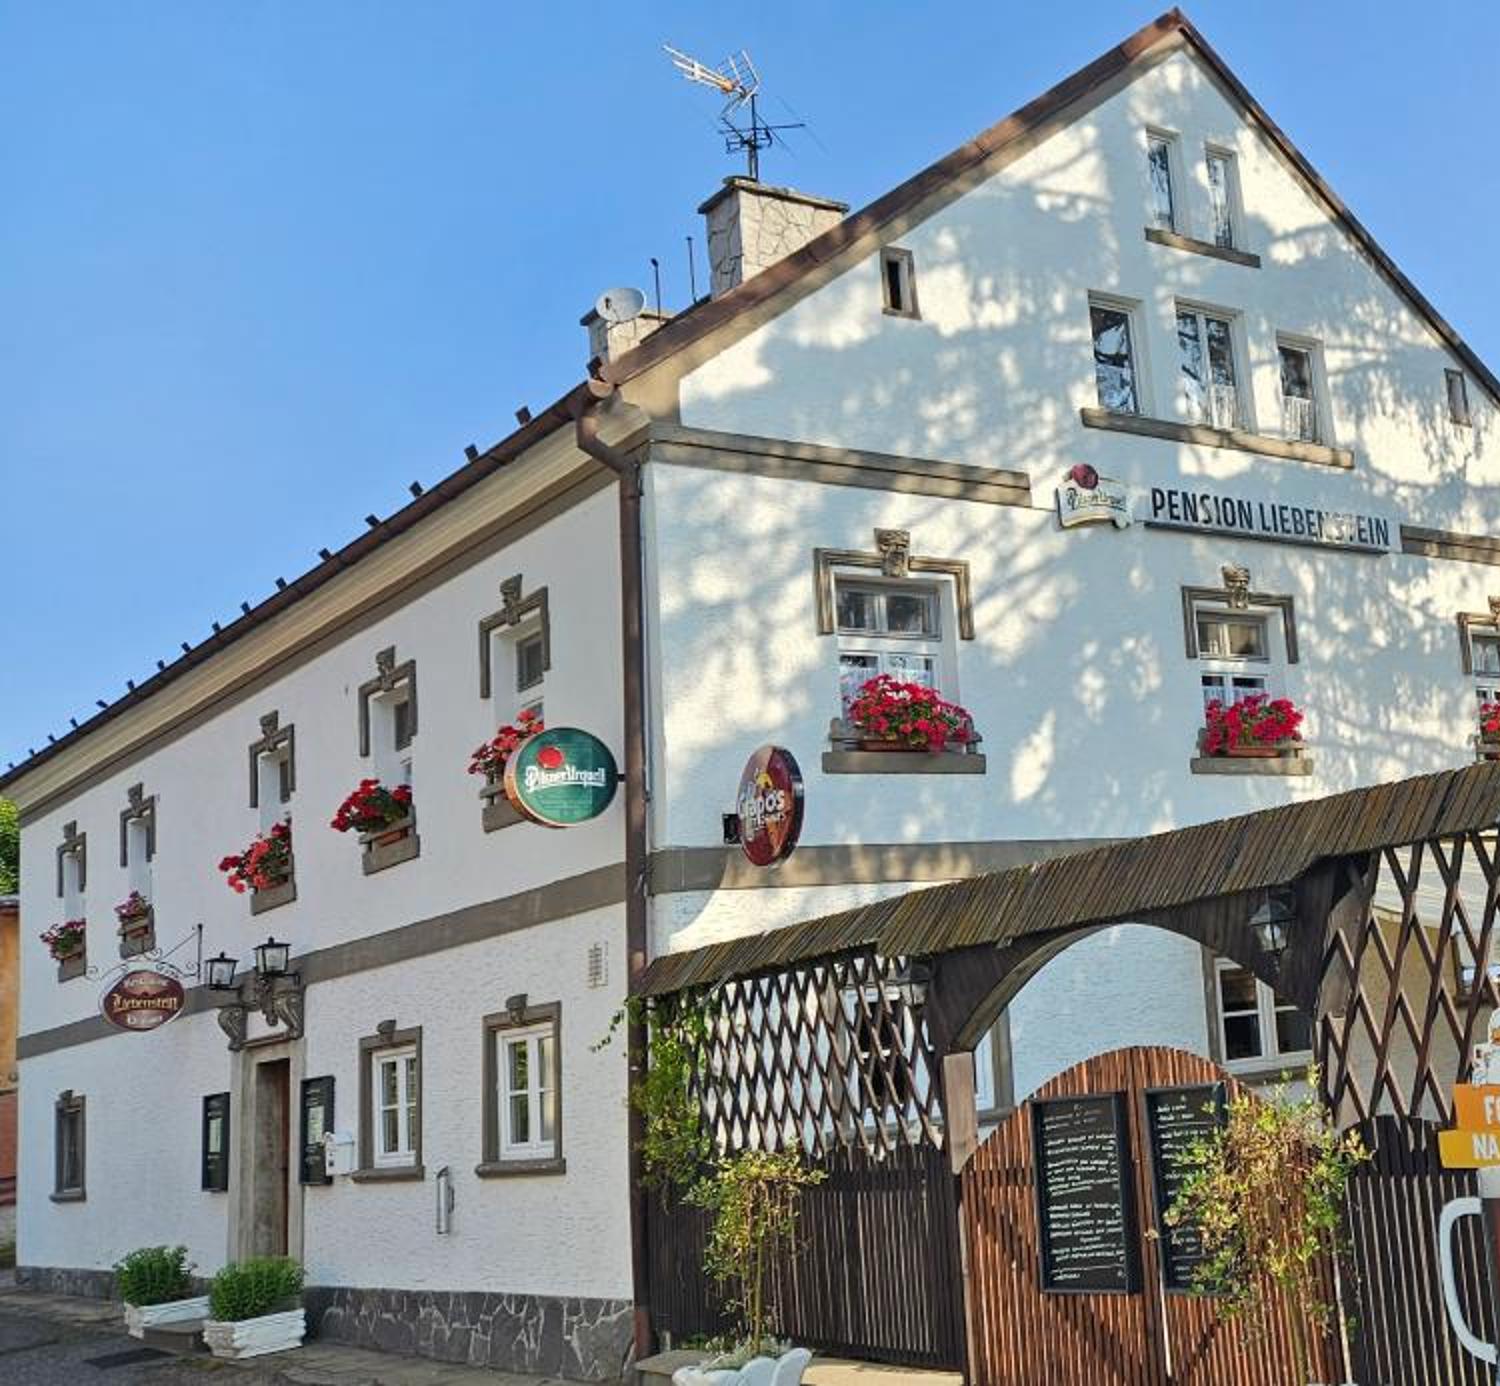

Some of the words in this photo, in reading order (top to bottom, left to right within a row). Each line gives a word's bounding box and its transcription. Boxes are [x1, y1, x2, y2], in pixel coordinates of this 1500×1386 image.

[1151, 487, 1253, 529] PENSION
[1259, 502, 1390, 546] LIEBENSTEIN
[1472, 1132, 1500, 1160] NA
